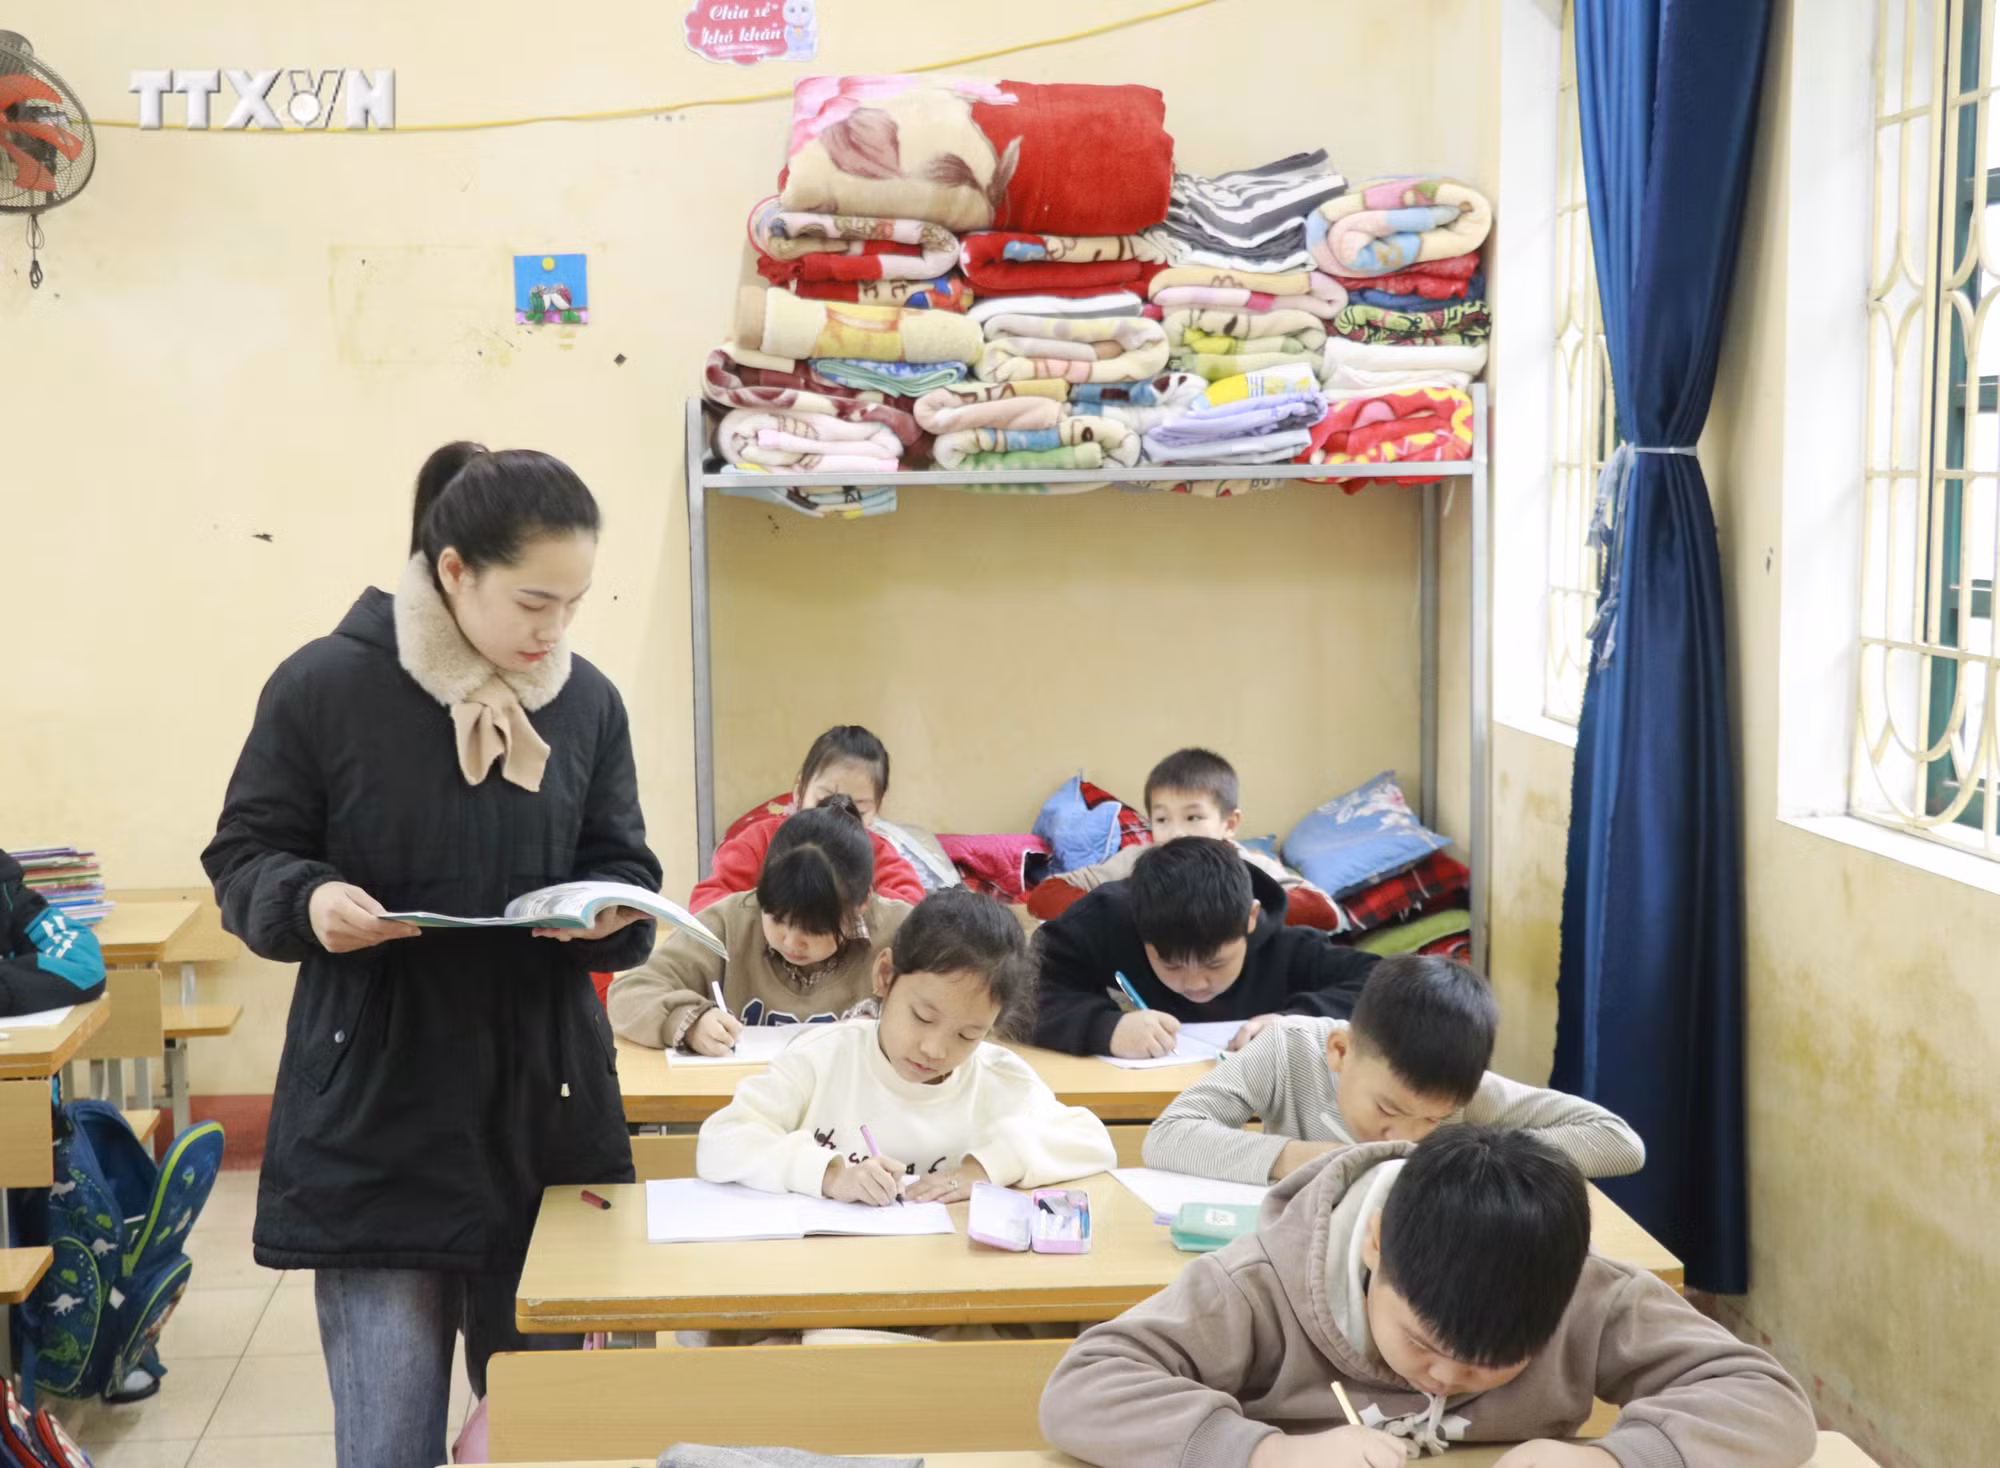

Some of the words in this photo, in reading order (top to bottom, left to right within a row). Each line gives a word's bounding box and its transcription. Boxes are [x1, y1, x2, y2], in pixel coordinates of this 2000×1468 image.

[709, 4, 749, 21] Chia
[701, 26, 733, 45] khó
[739, 26, 782, 42] khăn
